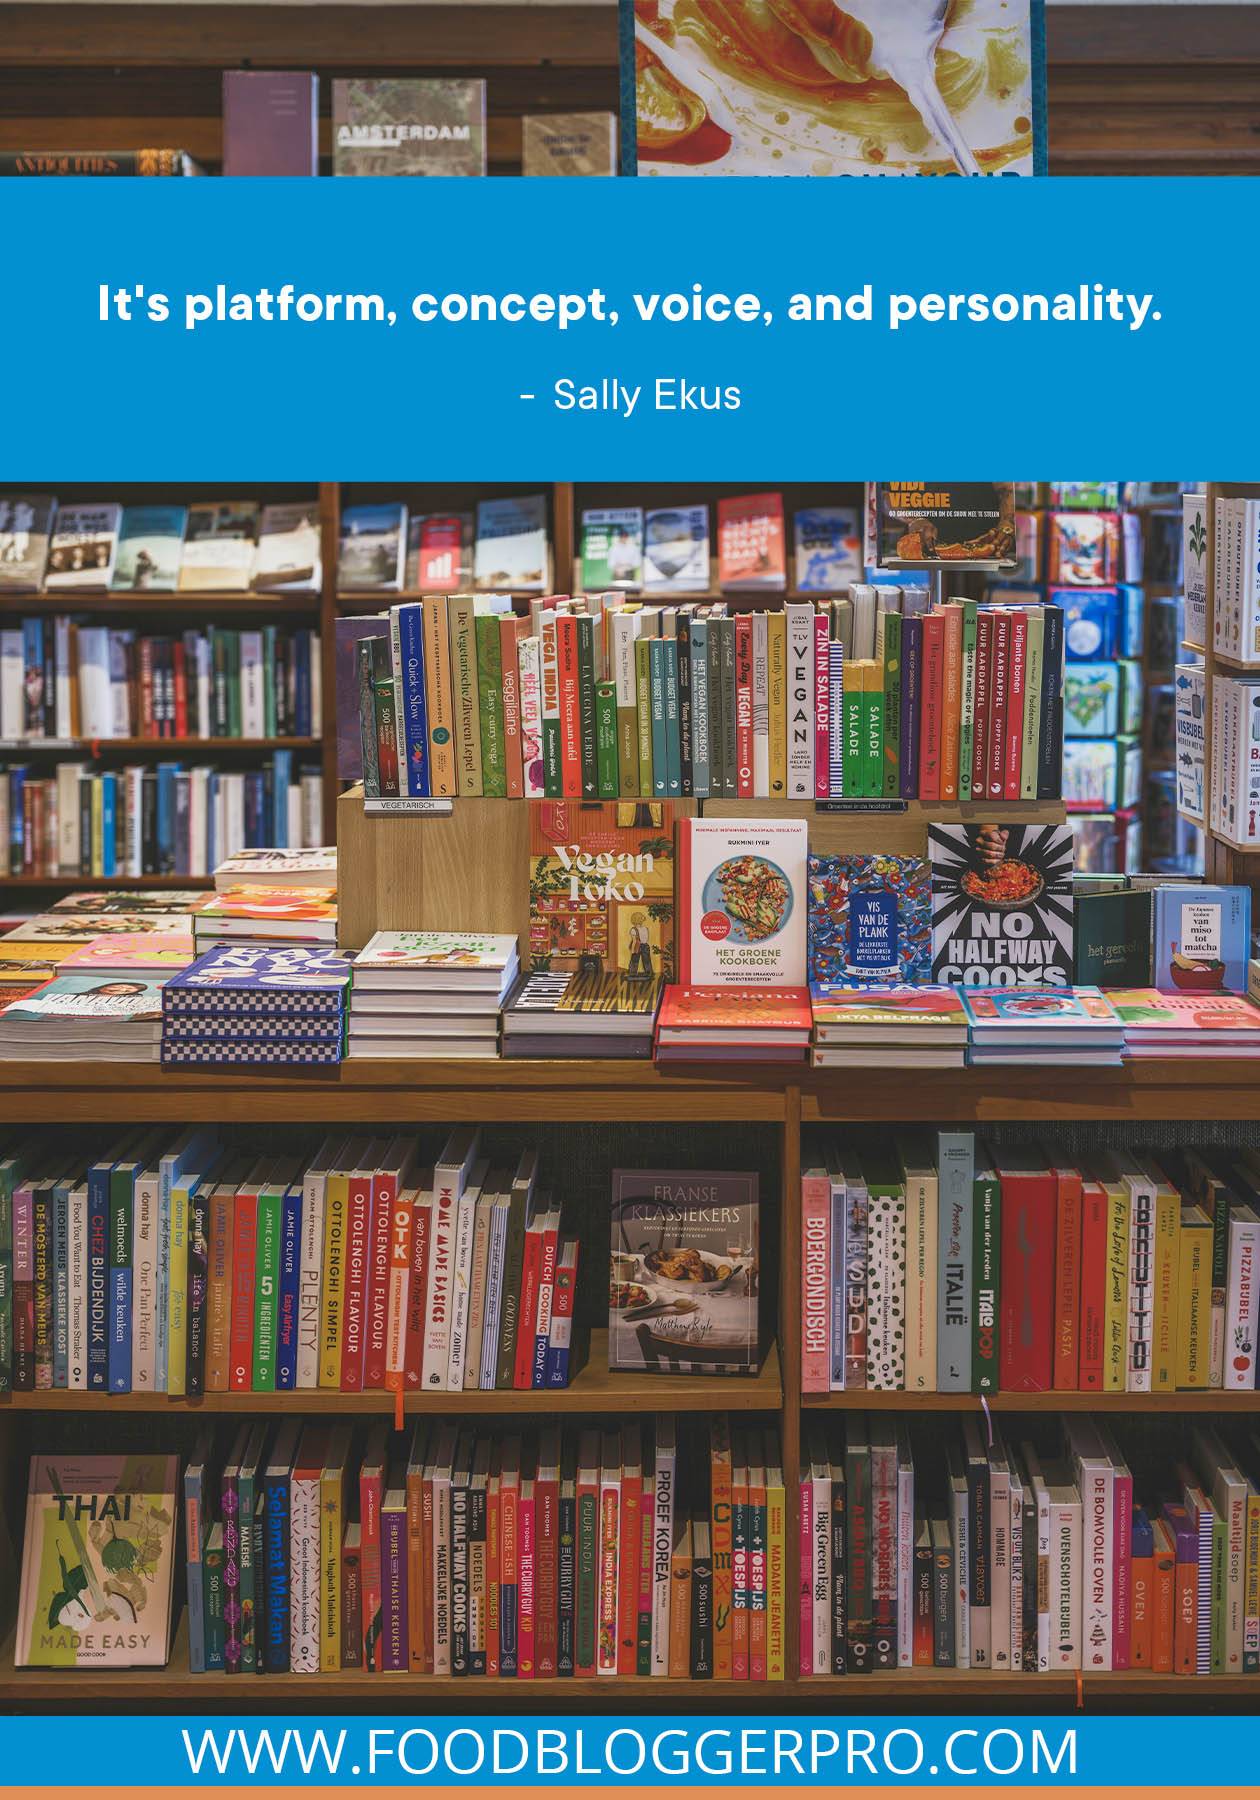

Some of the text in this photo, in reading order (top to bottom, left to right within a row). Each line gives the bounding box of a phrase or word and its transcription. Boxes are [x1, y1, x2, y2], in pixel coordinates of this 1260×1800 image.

[338, 124, 470, 140] AMSTERDAM
[889, 493, 950, 507] VEGGIE
[978, 623, 987, 648] PUUR
[542, 623, 556, 711] VEGA INDIA
[817, 629, 828, 731] ZIN IN SALADE
[977, 652, 987, 708] AARDAPPEL
[995, 622, 1006, 709] PUUR AARDAPPEL
[503, 671, 518, 735] veggilaine
[698, 659, 707, 762] HET VEGAN KOOKBOEK
[738, 687, 751, 727] VEGAN
[487, 689, 498, 764] Easy curry vega
[849, 705, 859, 756] SALADE
[869, 706, 880, 758] SALADE
[381, 802, 435, 810] VEGETARISCH
[552, 845, 654, 878] Vegan
[561, 875, 644, 902] Toko
[867, 902, 880, 912] VIS
[859, 914, 889, 925] VAN DE
[859, 928, 889, 938] PLANK
[971, 911, 1034, 938] NO
[716, 949, 781, 957] HET GROENE
[720, 957, 777, 966] KOOKBOEK
[948, 940, 1057, 964] HALFWAY
[1184, 943, 1217, 951] matcha
[937, 965, 1068, 986] COOKS
[73, 1202, 82, 1223] Food
[654, 1185, 719, 1202] FRANSE
[983, 1188, 992, 1213] Vanja
[73, 1224, 82, 1240] You
[91, 1215, 103, 1254] CHEZ
[287, 1209, 295, 1238] JAMIE
[632, 1207, 741, 1223] KLASSIEKERS
[17, 1204, 28, 1270] WINTER
[73, 1242, 82, 1263] Want
[285, 1240, 294, 1273] OLIVER
[414, 1218, 426, 1272] van boven
[432, 1188, 452, 1323] HOME MADE BASICS
[984, 1233, 992, 1247] der
[36, 1204, 46, 1345] DE MOSTERD VAN MEUS
[57, 1199, 66, 1355] JEROEN MEUS KLASSIEKE KOST
[73, 1274, 81, 1288] Eat
[115, 1208, 127, 1342] welmoeds wilde keuken
[139, 1191, 152, 1352] donna hay One Pan Perfect
[326, 1200, 342, 1351] OTTOLENGHI SIMPEL
[348, 1193, 364, 1353] OTTOLENGHI FLAVOUR
[372, 1191, 390, 1349] OTTOLENGHI FLAVOUR
[983, 1249, 992, 1280] Leeden
[91, 1257, 105, 1342] BIJDENDIJK
[283, 1294, 293, 1313] Easy
[558, 1294, 568, 1311] 500
[806, 1217, 826, 1353] BOERGONDISCH
[945, 1263, 968, 1326] ITALIË
[73, 1296, 82, 1330] Thomas
[301, 1270, 318, 1351] PLENTY
[503, 1295, 516, 1352] GOODNESS
[535, 1246, 554, 1370] DUTCH COOKING TODAY
[73, 1331, 82, 1360] Straker
[52, 1495, 131, 1521] THAI
[423, 1493, 432, 1521] SUSHI
[655, 1470, 672, 1583] PROEF KOREA
[583, 1501, 592, 1573] PUUR INDIA
[958, 1517, 966, 1541] SUSHI
[995, 1527, 1005, 1567] HOMMAGE
[1093, 1478, 1104, 1603] DE BOMVOLLE OVEN
[1229, 1501, 1243, 1583] Maaltijd soep
[268, 1486, 288, 1645] Selamat Makan
[453, 1491, 466, 1633] NO HALFWAY COOKS
[473, 1544, 483, 1593] NOEDELS
[605, 1552, 613, 1578] INDIA
[815, 1511, 829, 1601] Big Green Egg
[958, 1550, 967, 1585] CEVICHE
[301, 1537, 310, 1636] Groot Indonesisch kookboek
[437, 1544, 447, 1645] MAKKELIJKE NOEDELS
[521, 1554, 532, 1632] THE CURRY GUY KIP
[560, 1554, 572, 1611] CURRY GUY
[734, 1546, 746, 1609] TOESPIJS
[604, 1580, 613, 1620] EXPRESS
[698, 1583, 707, 1628] 500 sushi
[771, 1544, 781, 1657] MADAME JEANETTE
[1135, 1581, 1145, 1621] OVEN
[1182, 1588, 1192, 1624] SOEP
[40, 1635, 151, 1649] MADE EASY
